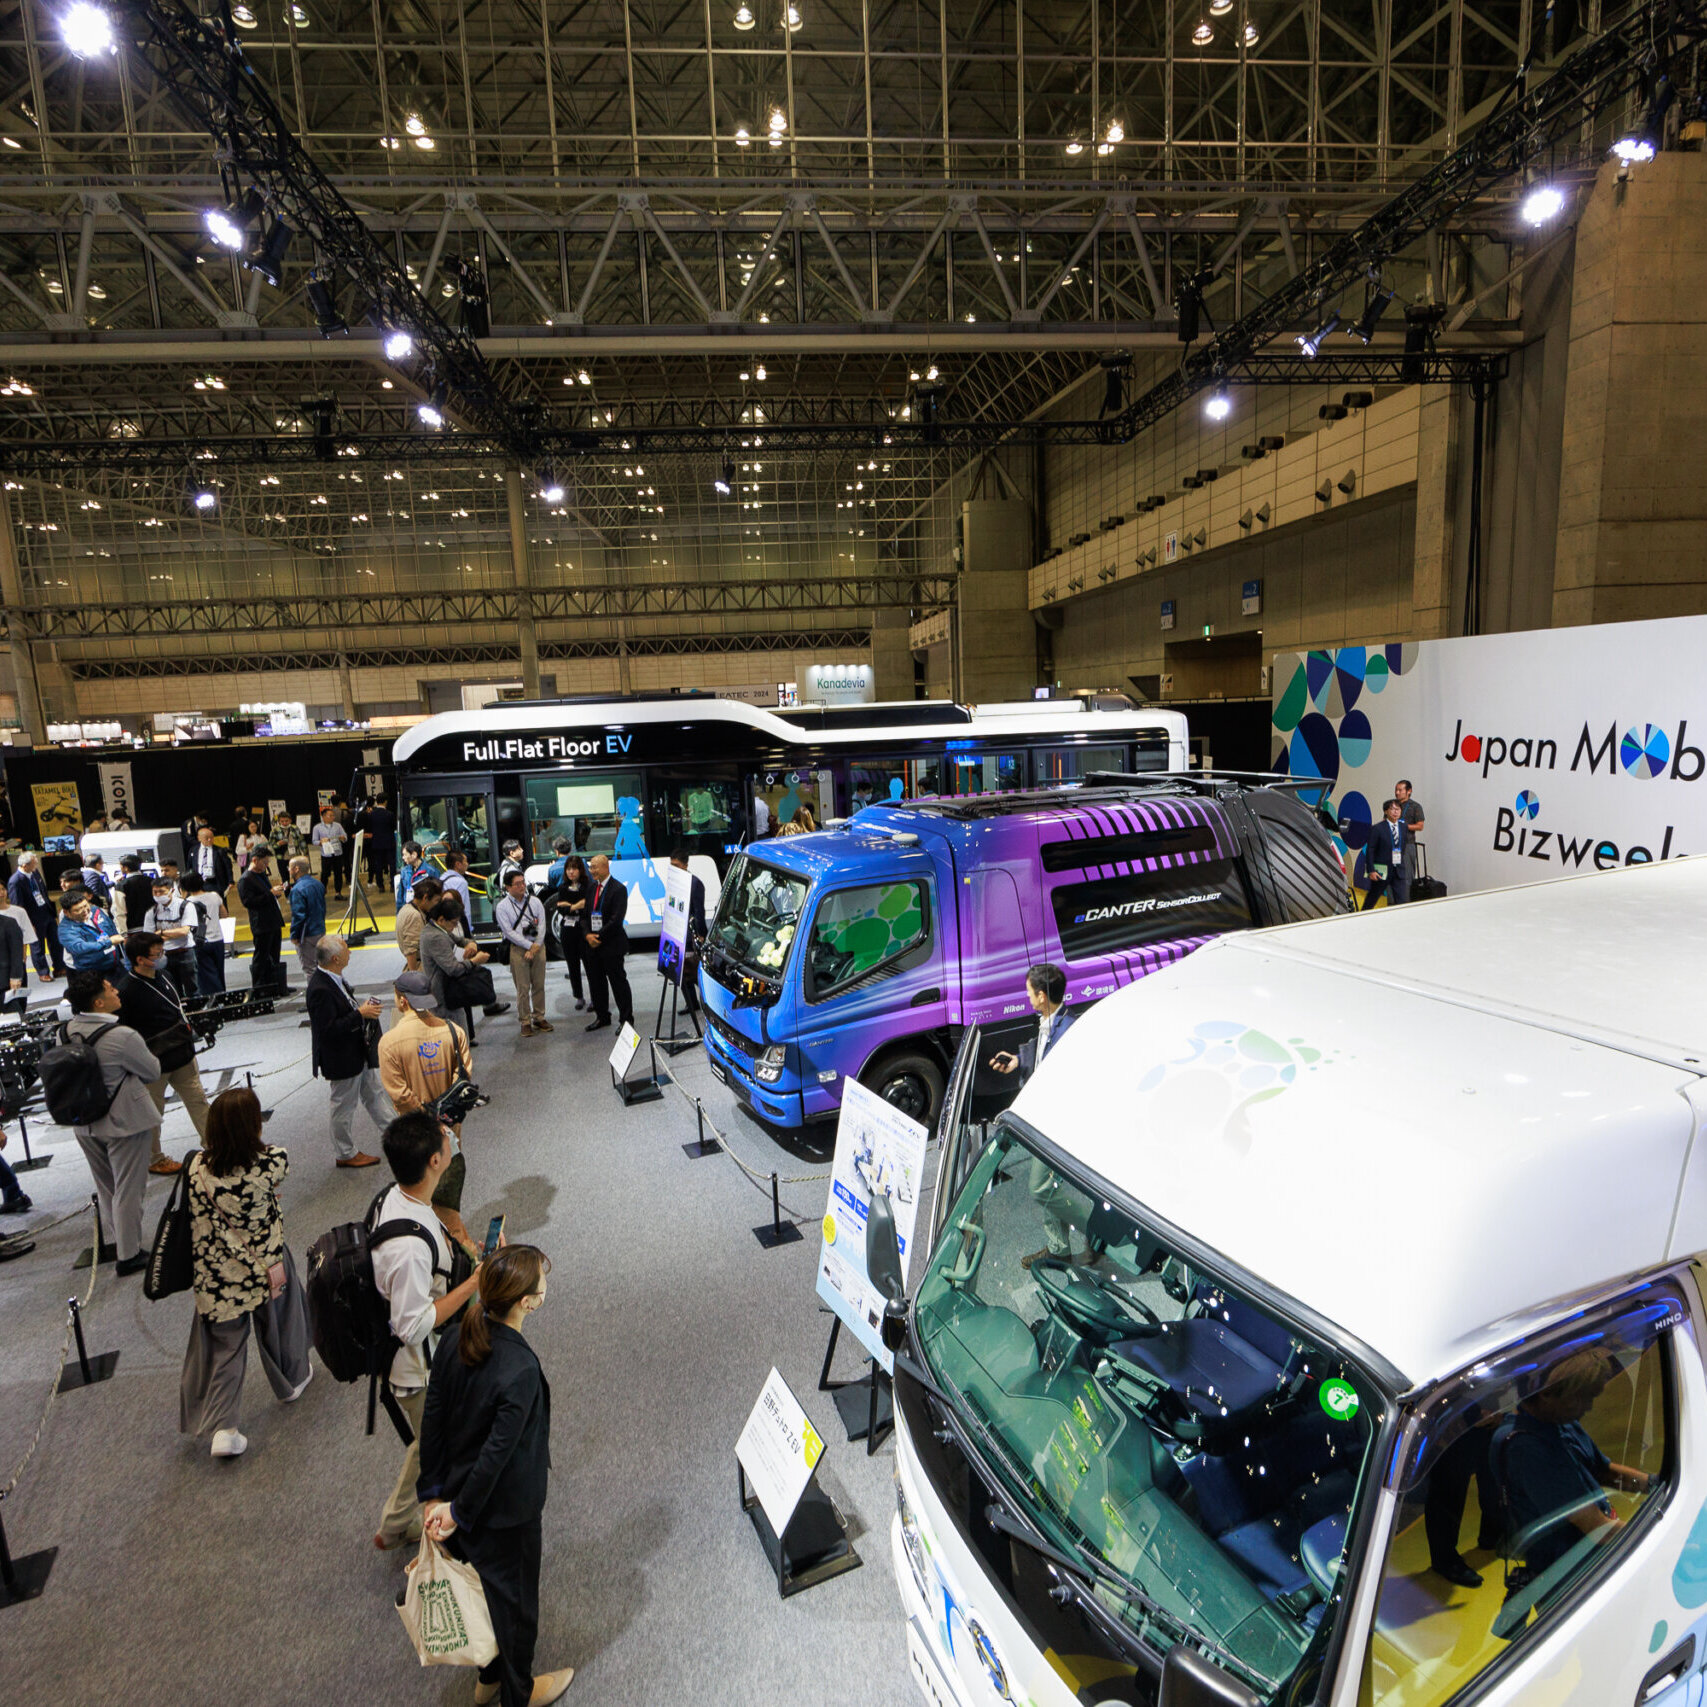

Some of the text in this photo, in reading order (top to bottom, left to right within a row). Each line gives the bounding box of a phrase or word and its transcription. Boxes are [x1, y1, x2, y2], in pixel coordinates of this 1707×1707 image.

[816, 676, 865, 689] Kanadevia
[718, 690, 769, 699] EATEC 2024
[463, 734, 633, 761] Full Flat Floor EV
[1445, 719, 1558, 779] Japan
[110, 775, 128, 810] ICOM
[1074, 899, 1156, 924] eCANTER
[1003, 1004, 1026, 1015] Nikon
[1655, 1312, 1682, 1330] HINO
